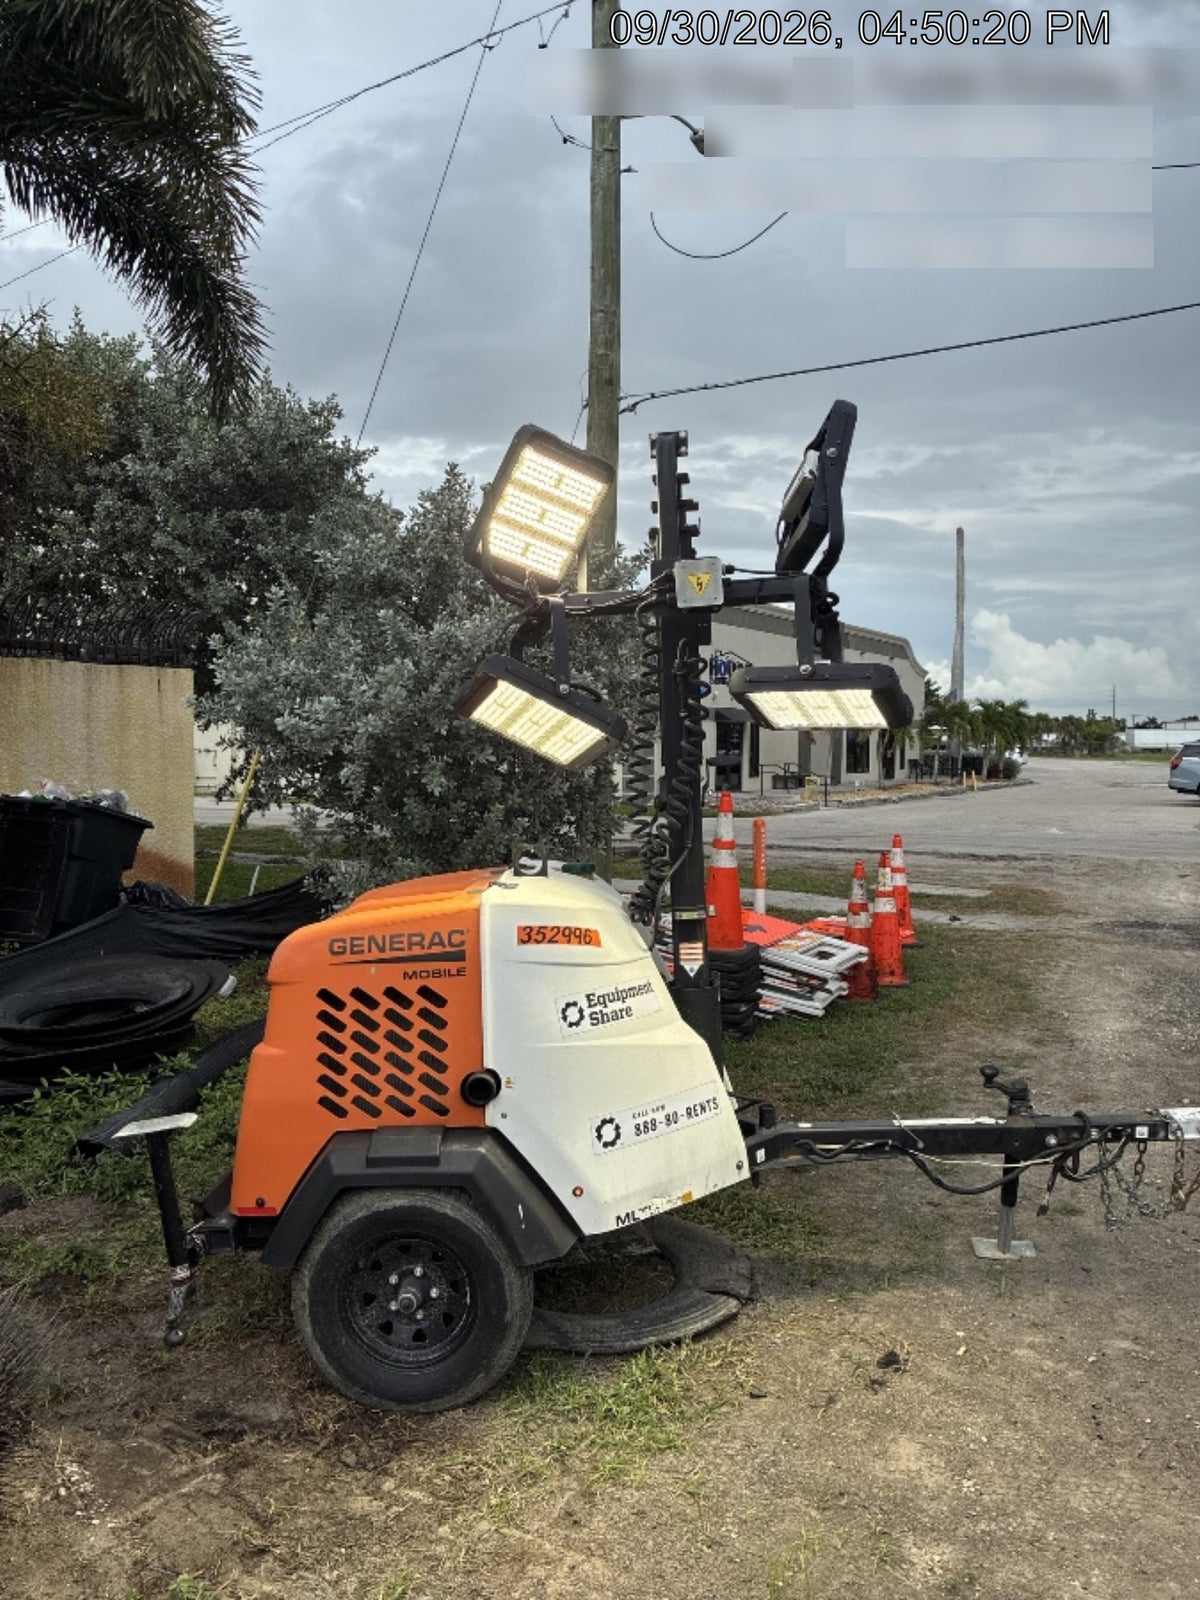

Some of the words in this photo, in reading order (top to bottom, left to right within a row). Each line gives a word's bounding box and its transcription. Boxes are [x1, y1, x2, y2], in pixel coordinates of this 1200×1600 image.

[328, 929, 467, 956] GENERAC
[520, 925, 593, 945] 352996
[402, 966, 467, 981] MOBILE
[585, 979, 655, 1009] Equipment
[589, 1005, 634, 1027] Share
[634, 1096, 719, 1136] 888-80-RENTS
